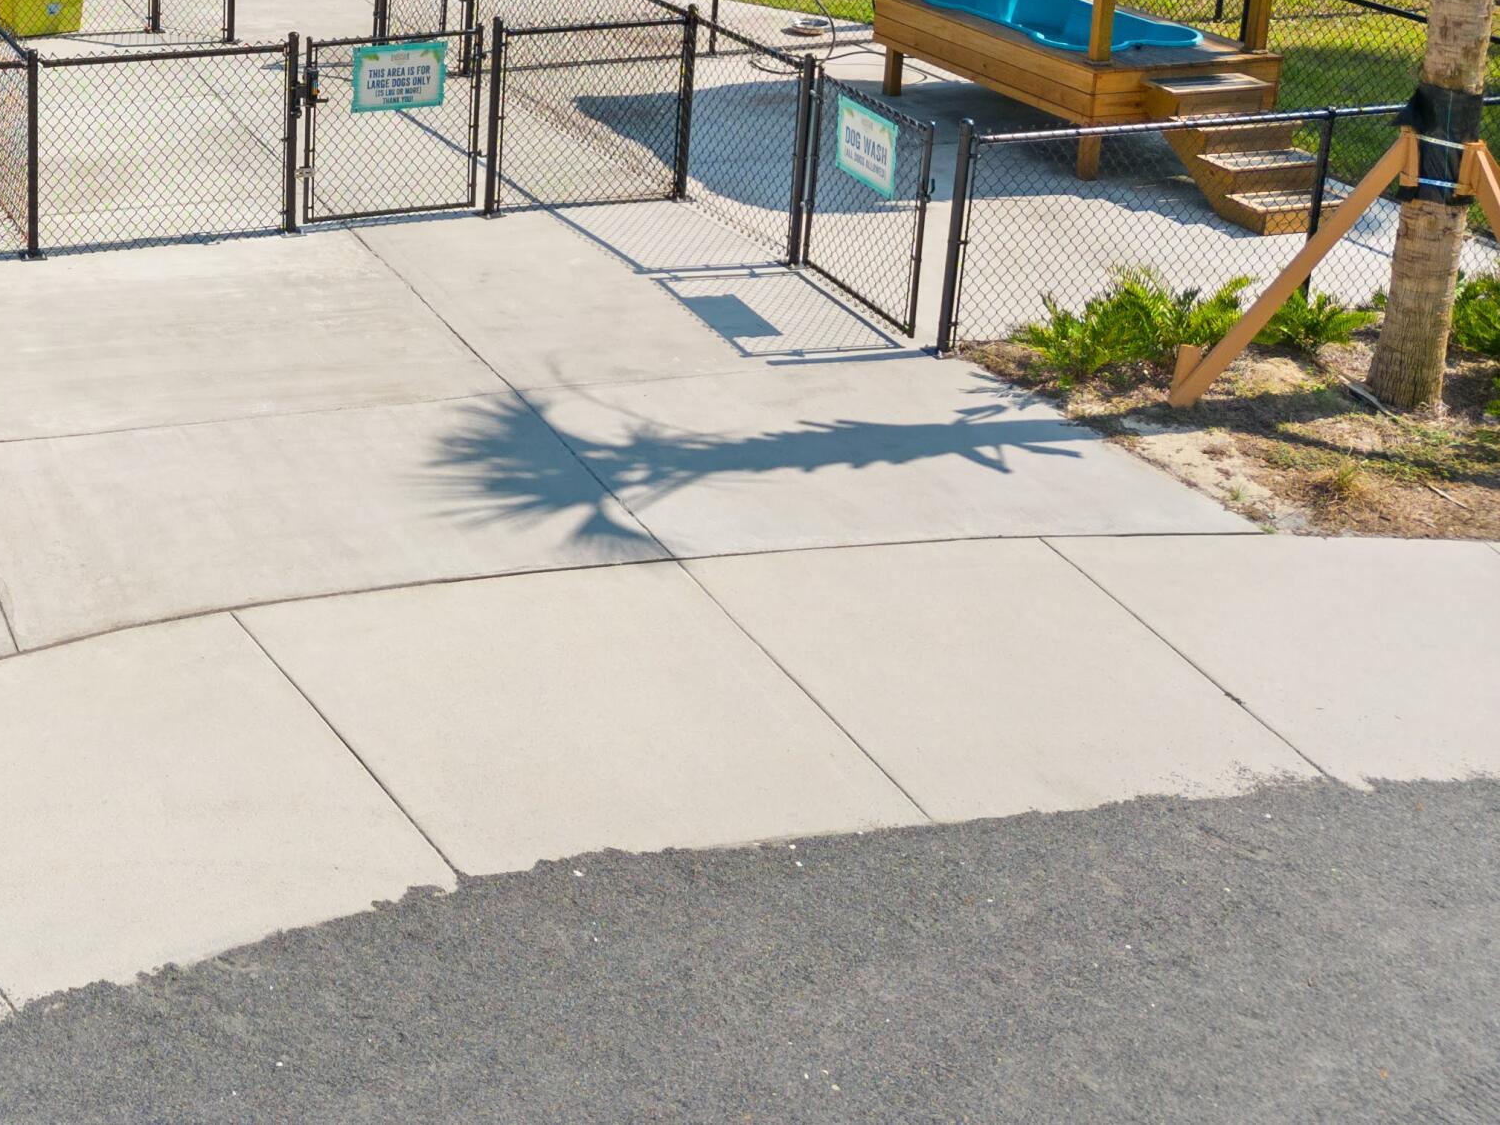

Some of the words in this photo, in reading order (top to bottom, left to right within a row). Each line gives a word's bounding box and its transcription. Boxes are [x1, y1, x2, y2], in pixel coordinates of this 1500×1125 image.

[369, 69, 385, 78] THIS
[387, 67, 405, 76] AREA
[407, 66, 415, 75] IS
[417, 65, 431, 75] FOR
[367, 79, 390, 90] LARGE
[392, 77, 410, 88] DOGS
[412, 76, 431, 86] ONLY
[845, 125, 861, 151] DOG
[864, 135, 887, 165] WASH
